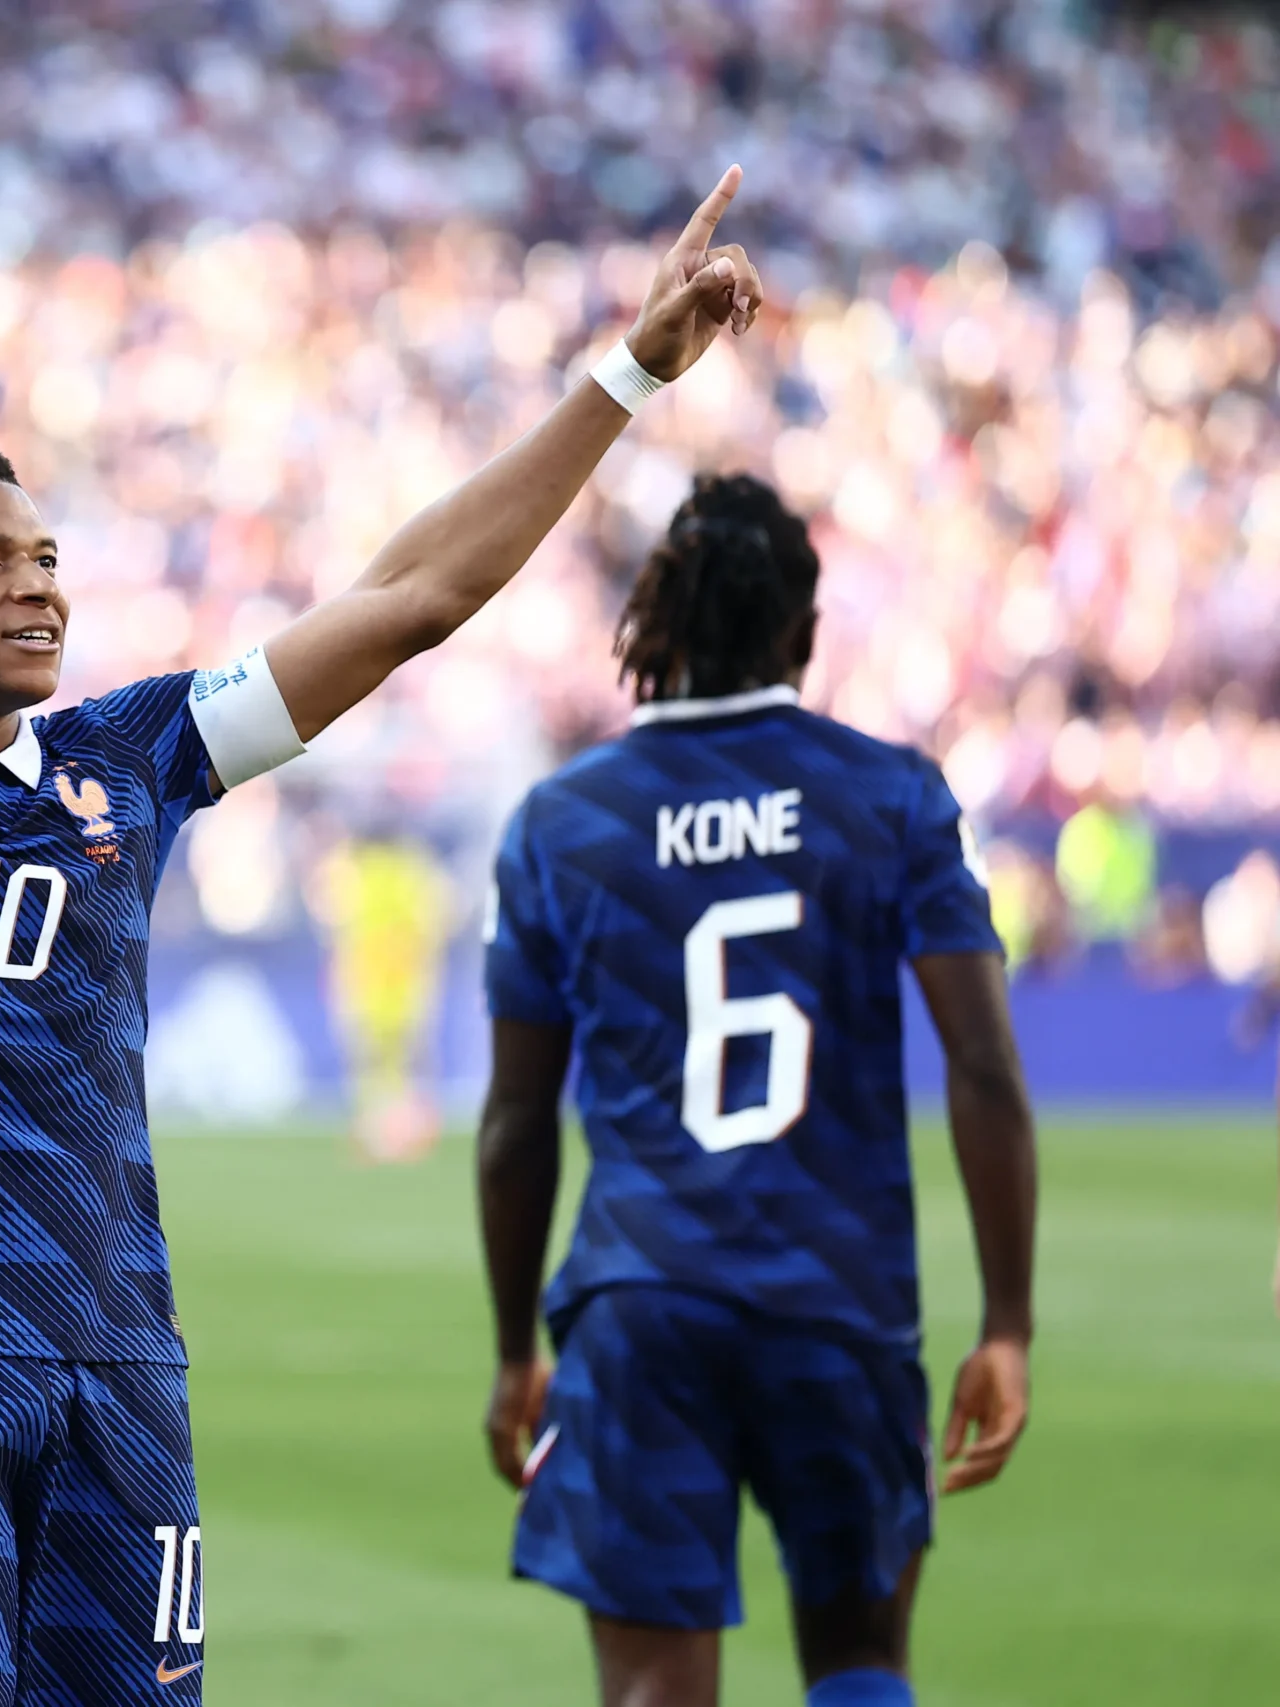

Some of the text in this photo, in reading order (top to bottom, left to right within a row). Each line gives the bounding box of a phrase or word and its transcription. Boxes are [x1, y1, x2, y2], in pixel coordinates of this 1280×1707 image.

[656, 788, 802, 868] KONE
[681, 890, 814, 1153] 6
[153, 1525, 205, 1644] 10
